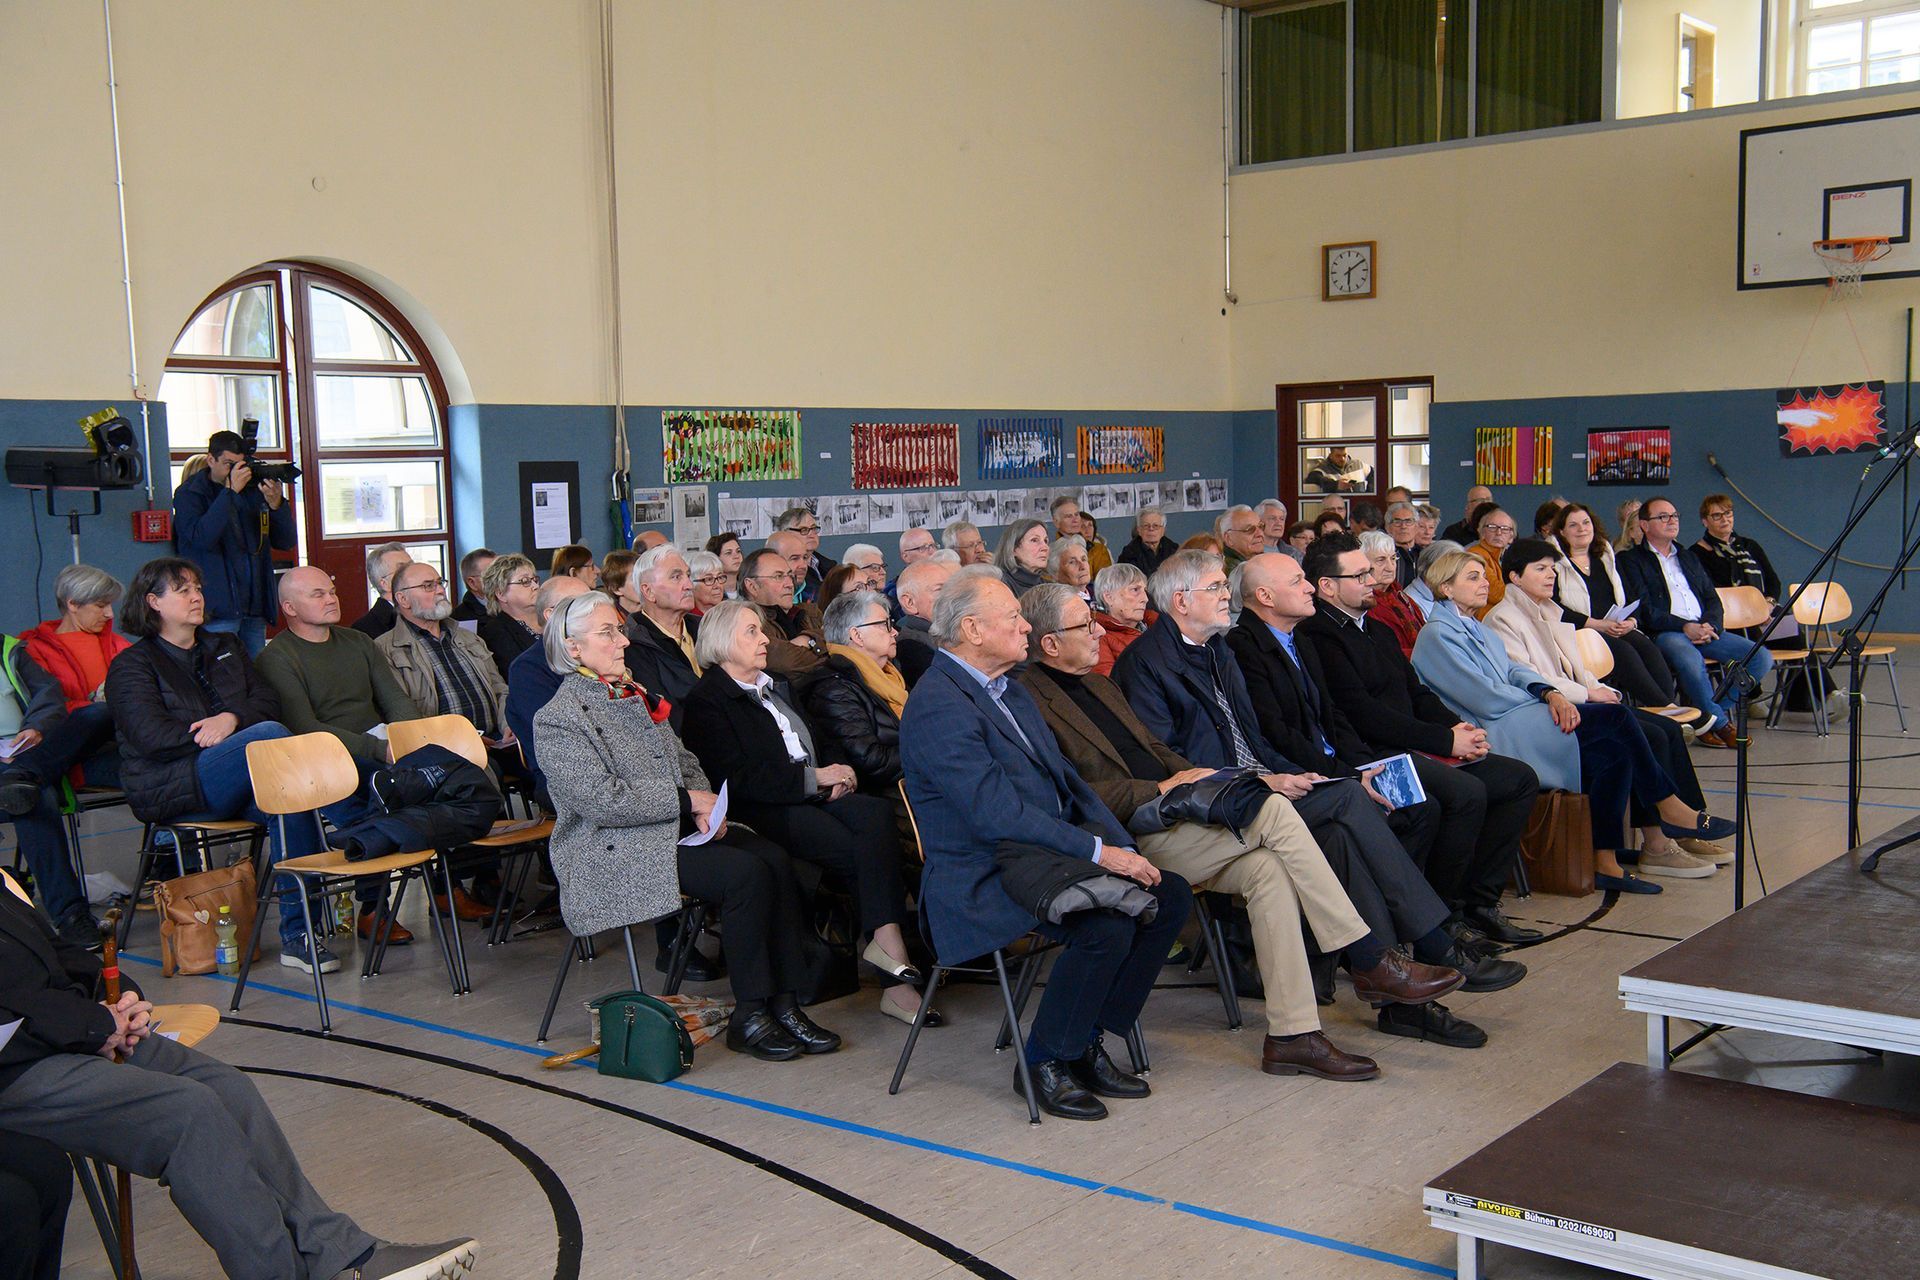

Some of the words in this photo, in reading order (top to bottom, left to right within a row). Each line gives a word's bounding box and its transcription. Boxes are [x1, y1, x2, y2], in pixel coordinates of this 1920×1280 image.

[1832, 192, 1866, 200] BENZ
[1525, 1211, 1556, 1227] Bühnen
[1557, 1219, 1615, 1240] 0202/469080
